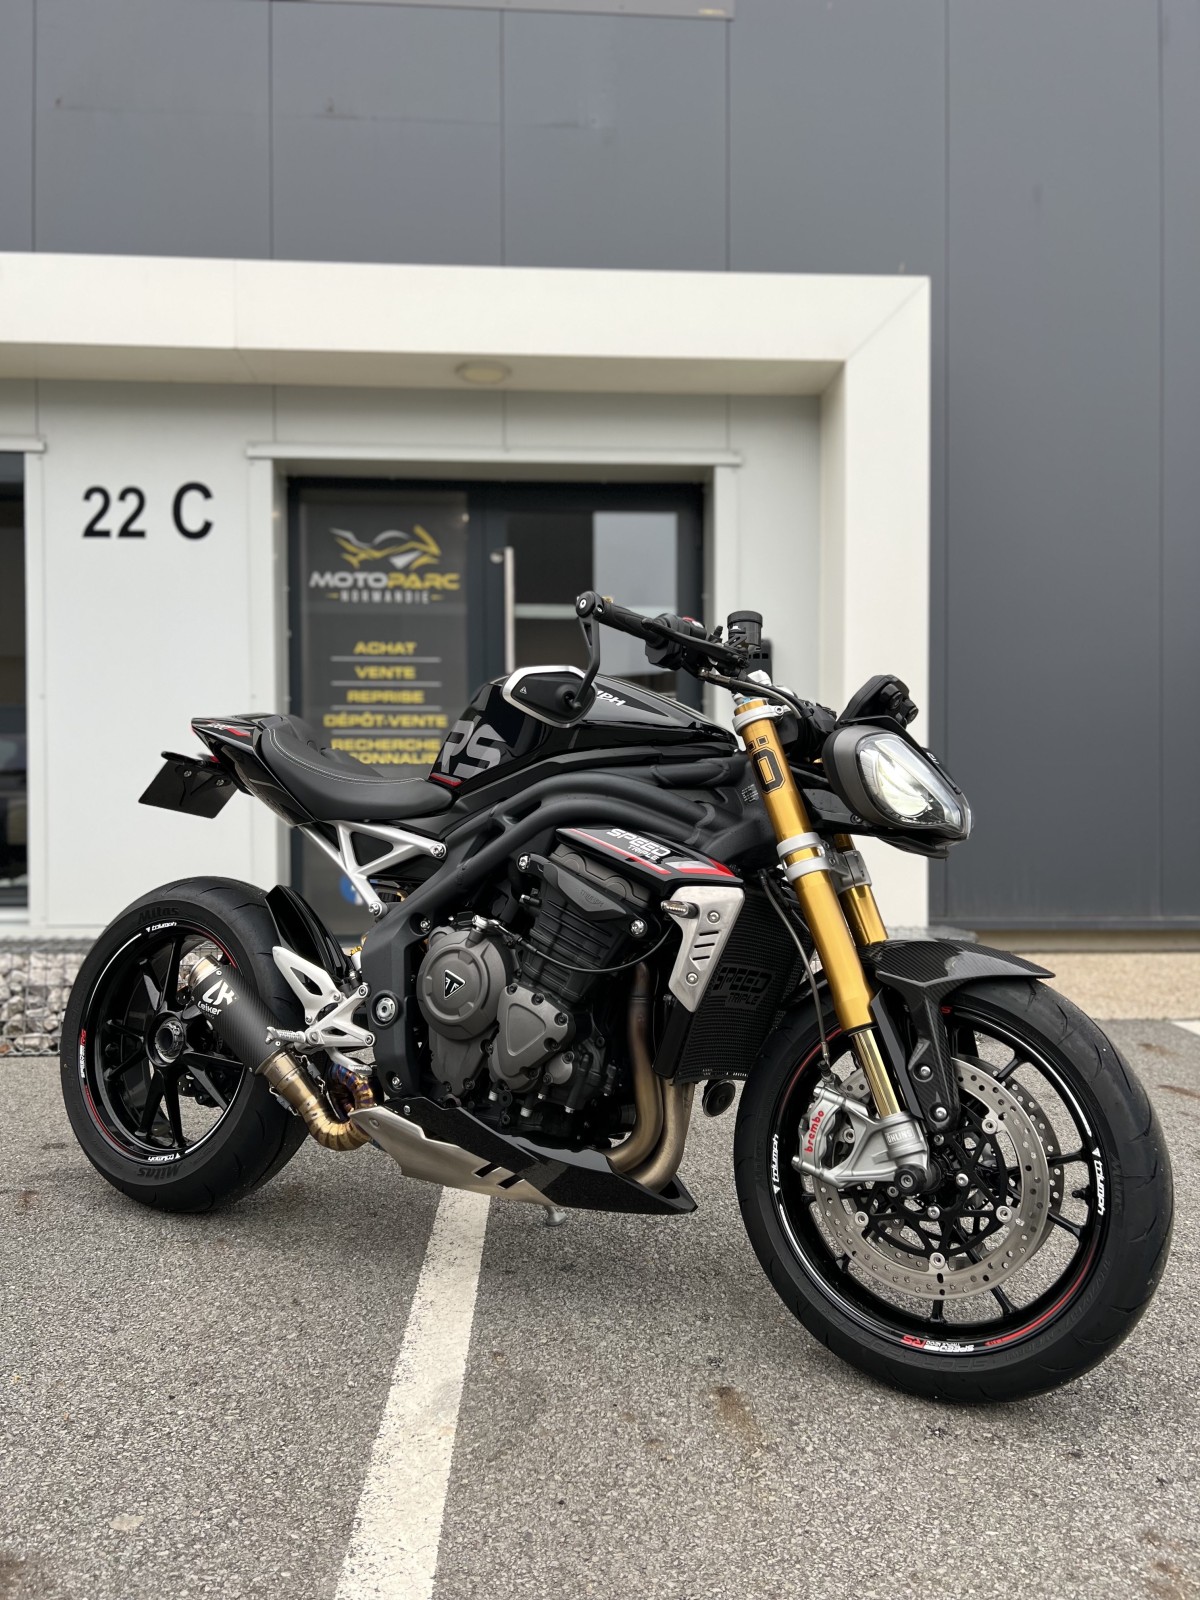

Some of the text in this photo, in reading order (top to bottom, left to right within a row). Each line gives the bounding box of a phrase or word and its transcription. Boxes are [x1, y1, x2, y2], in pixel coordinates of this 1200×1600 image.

[82, 481, 213, 540] 22 C
[309, 571, 460, 590] MOTOPARC
[340, 591, 429, 604] NORMANDIE
[353, 641, 417, 655] ACHAT
[354, 665, 416, 680] VENTE
[346, 690, 425, 704] REPRISE
[330, 738, 441, 751] RECHERCHE
[606, 828, 671, 856] SPEED
[628, 844, 660, 861] TRIPLE
[803, 1110, 825, 1153] brembo
[900, 1335, 925, 1349] RS
